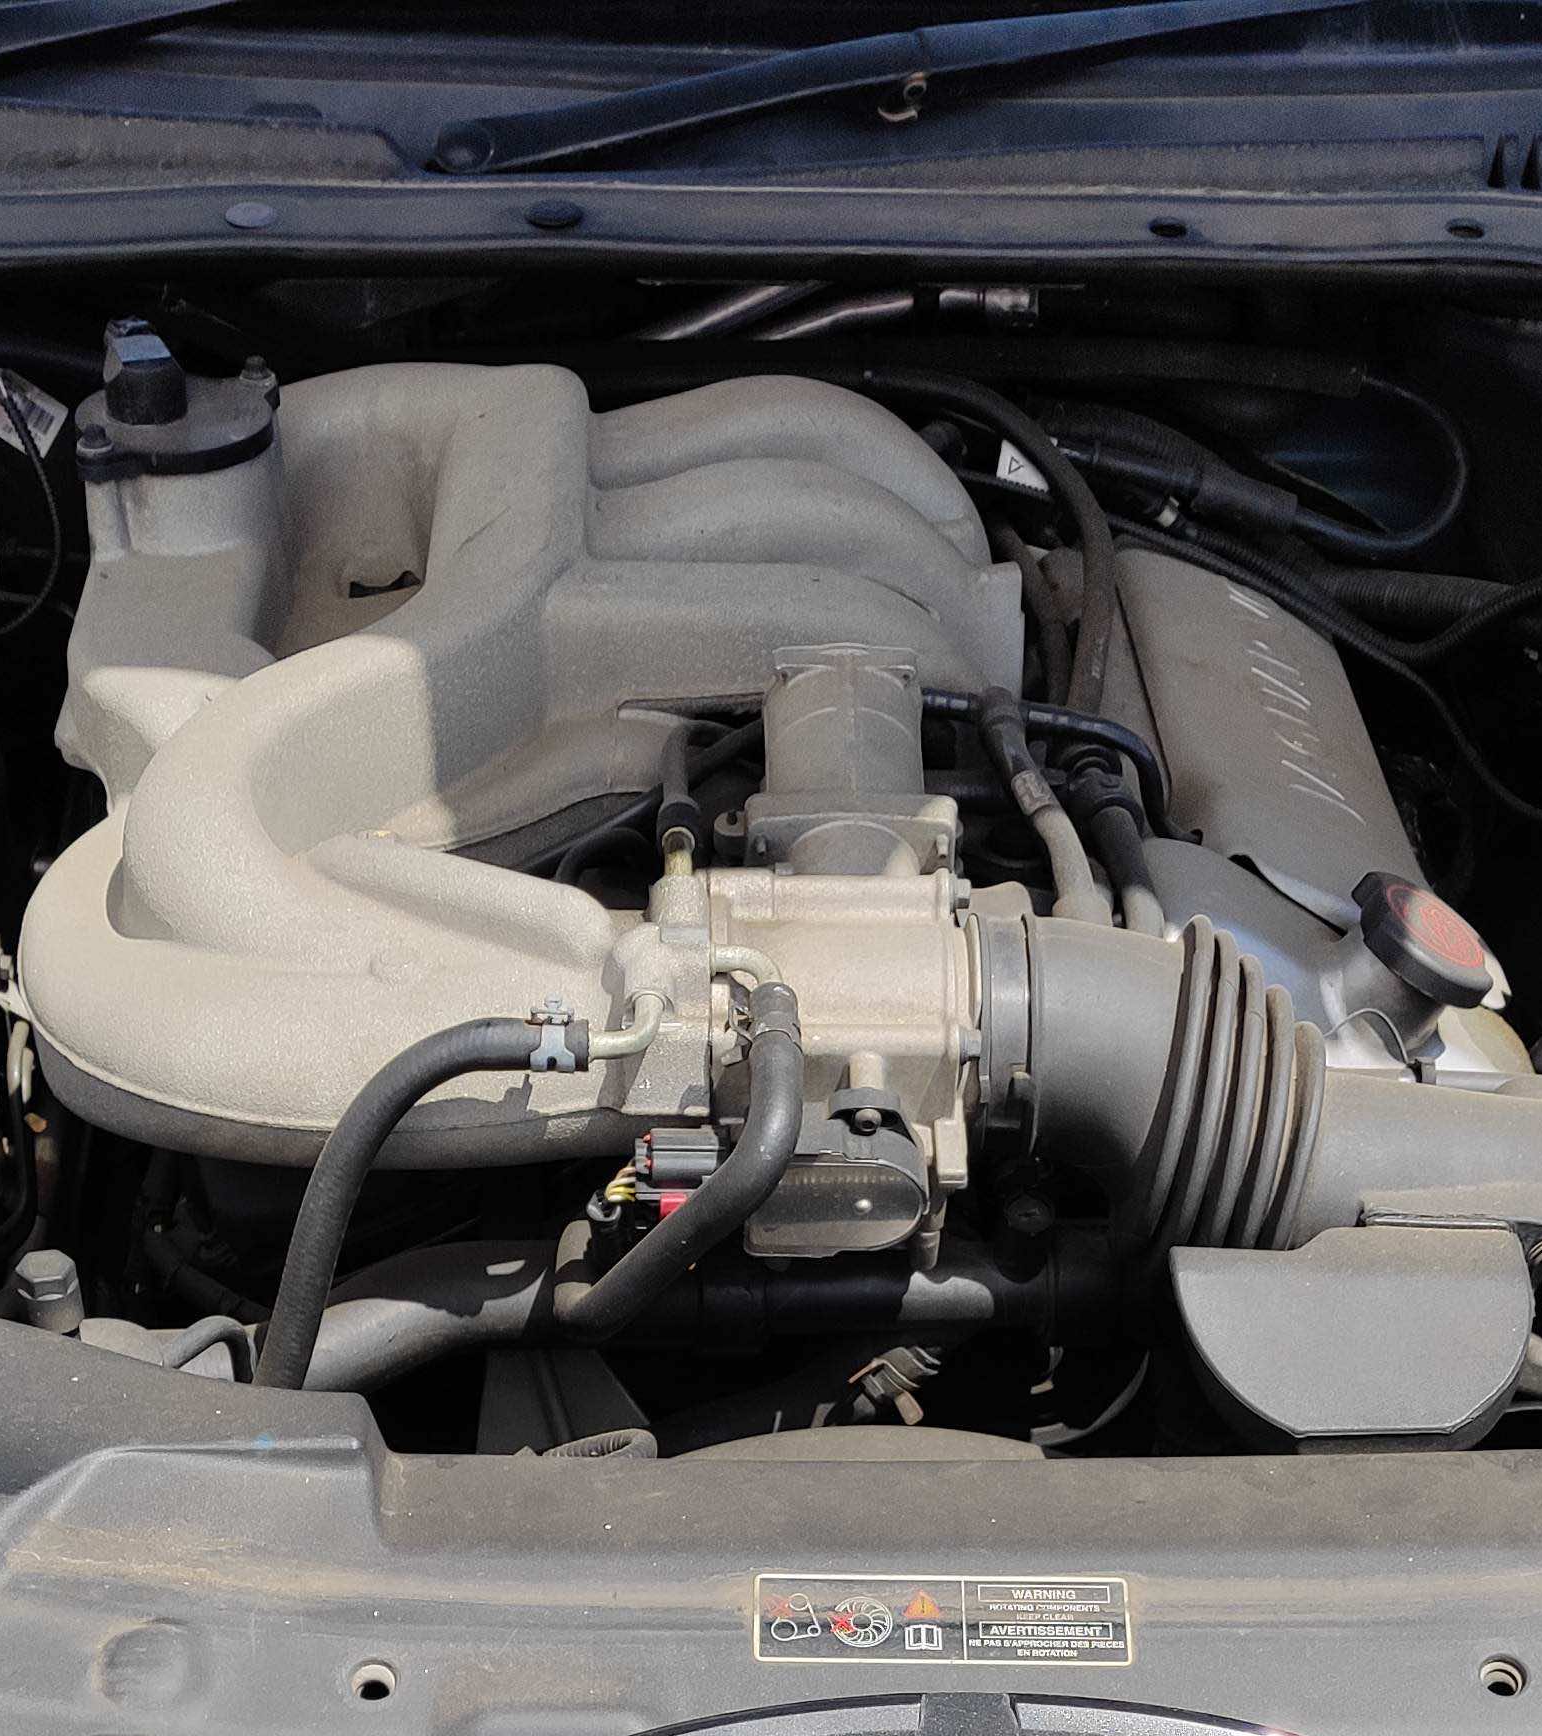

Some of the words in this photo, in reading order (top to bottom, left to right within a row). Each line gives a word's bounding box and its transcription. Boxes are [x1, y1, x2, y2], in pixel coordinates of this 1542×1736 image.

[1011, 1589, 1076, 1600] WARNING
[1035, 1604, 1100, 1612] COMPONENTS
[989, 1625, 1103, 1637] AVERTISSEMENT
[969, 1639, 982, 1647] NE
[1070, 1641, 1089, 1649] DES
[1017, 1649, 1030, 1657] EN
[1031, 1649, 1078, 1657] ROTATION
